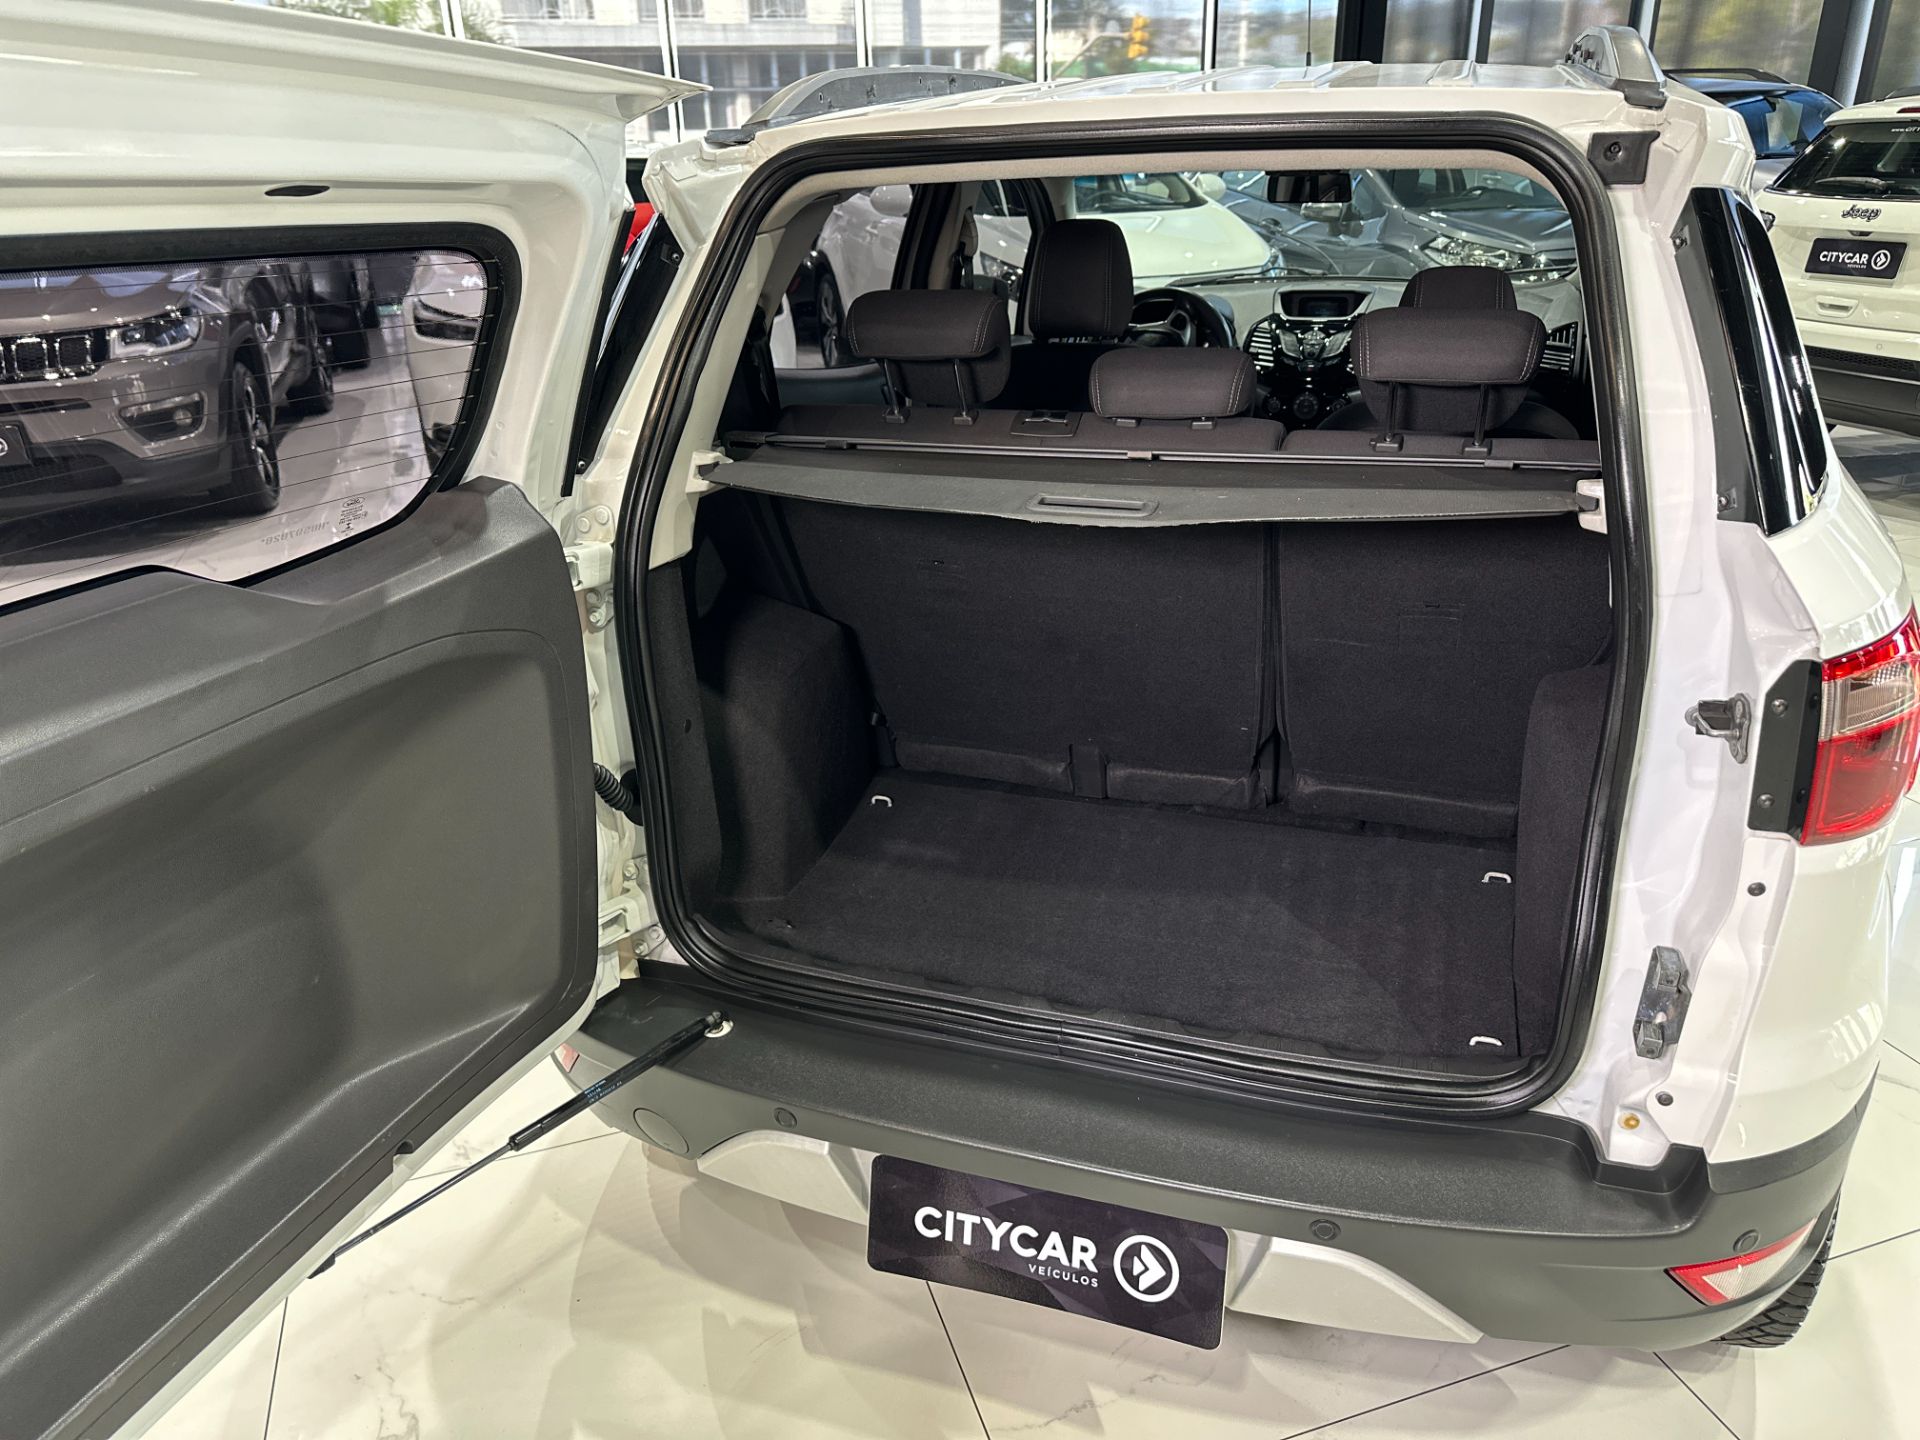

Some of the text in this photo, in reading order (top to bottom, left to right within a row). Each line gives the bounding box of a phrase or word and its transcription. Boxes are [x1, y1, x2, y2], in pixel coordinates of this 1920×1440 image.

[1841, 204, 1881, 222] Jeep
[1819, 251, 1869, 265] CITYCAR
[914, 1206, 1098, 1273] CITYCAR
[1028, 1263, 1099, 1288] VEÍCULOS
